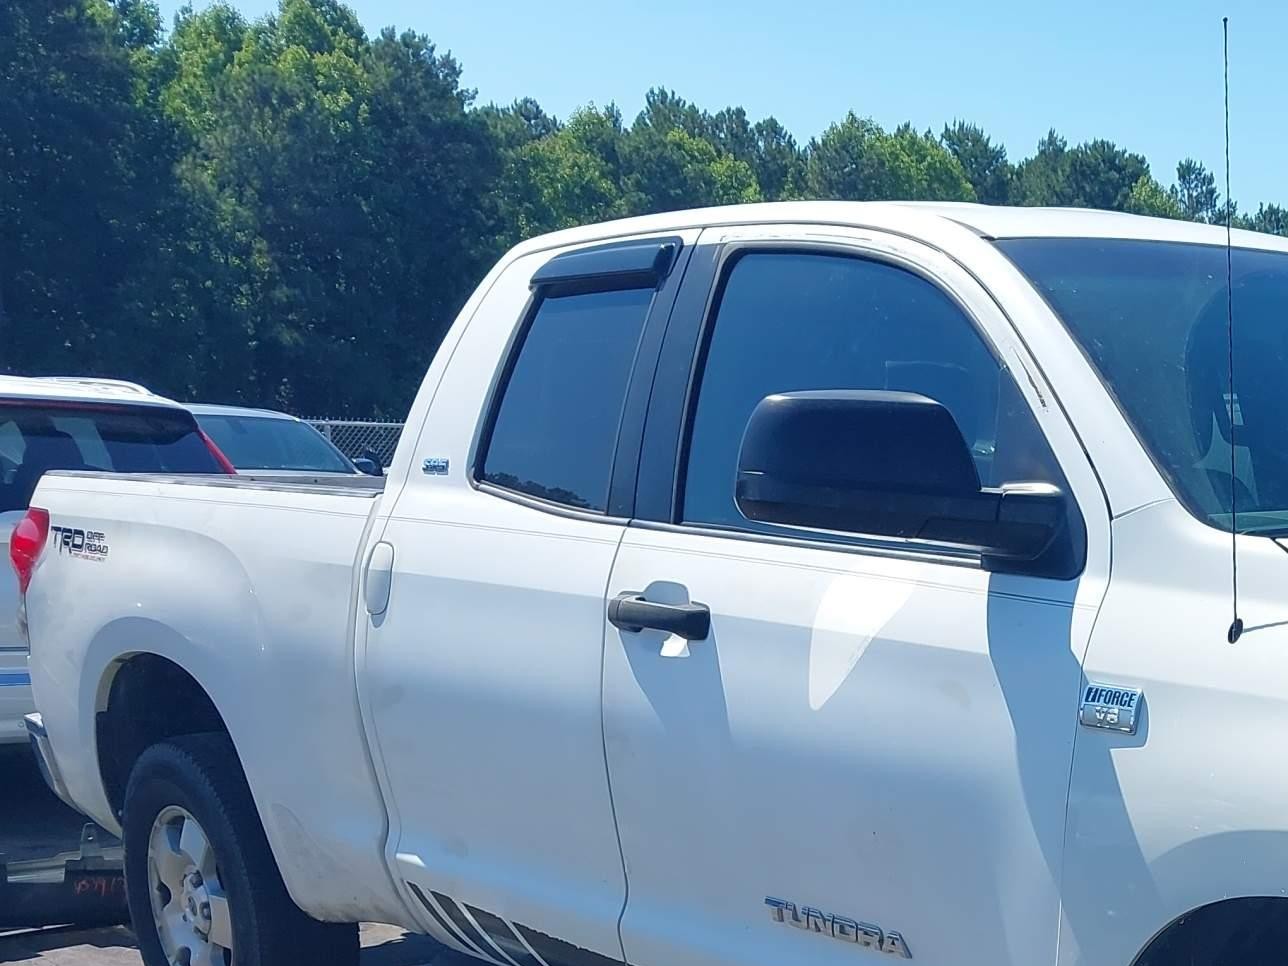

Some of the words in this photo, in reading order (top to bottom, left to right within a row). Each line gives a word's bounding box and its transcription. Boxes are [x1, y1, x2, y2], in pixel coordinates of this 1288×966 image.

[51, 525, 85, 555] TRD
[84, 542, 109, 556] ROAD
[764, 895, 913, 959] TUNDRA
